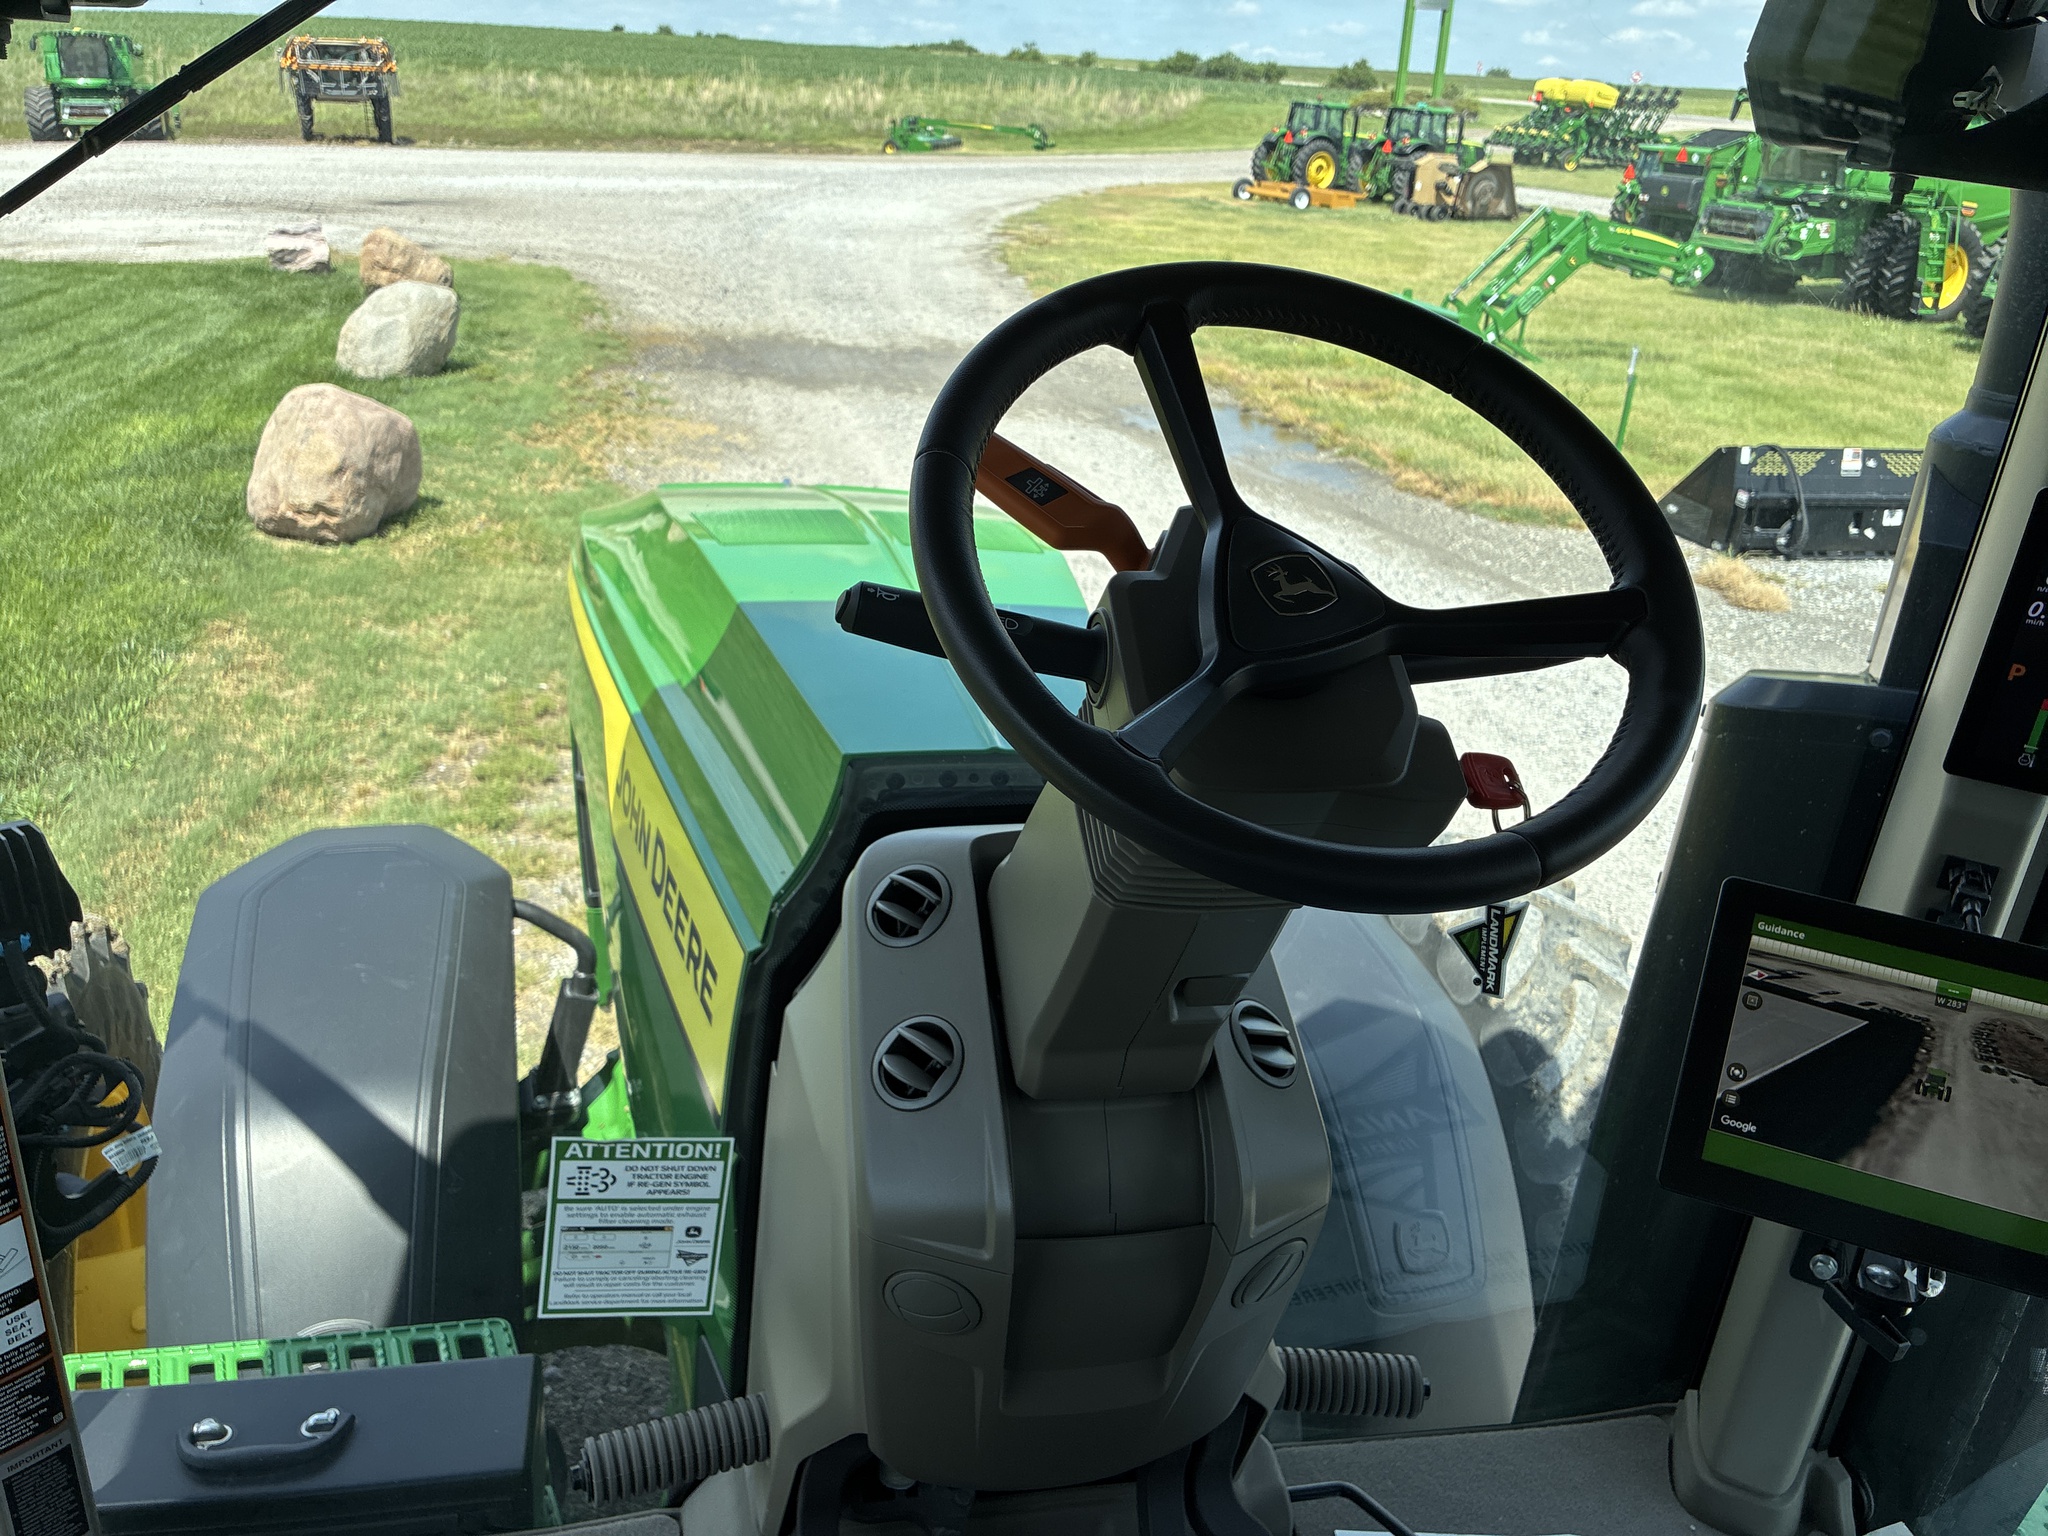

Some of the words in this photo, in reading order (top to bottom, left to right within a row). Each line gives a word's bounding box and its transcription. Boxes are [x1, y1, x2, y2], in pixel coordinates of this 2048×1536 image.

[2007, 663, 2027, 681] P
[616, 751, 651, 870] JOHN
[651, 826, 718, 1027] DEERE
[1757, 921, 1806, 941] Guidance
[1479, 927, 1488, 972] IMPLEMENT
[1485, 908, 1501, 992] LANDMARK
[1937, 996, 1946, 1005] W
[1720, 1114, 1757, 1134] Google
[564, 1142, 722, 1159] ATTENTION!
[5, 1318, 32, 1336] SEAT
[6, 1311, 28, 1326] USE
[7, 1327, 34, 1345] BELT
[4, 1349, 18, 1360] fully
[19, 1341, 35, 1352] from
[11, 1353, 24, 1363] and
[24, 1342, 45, 1357] adjust
[6, 1438, 63, 1473] IMPORTANT
